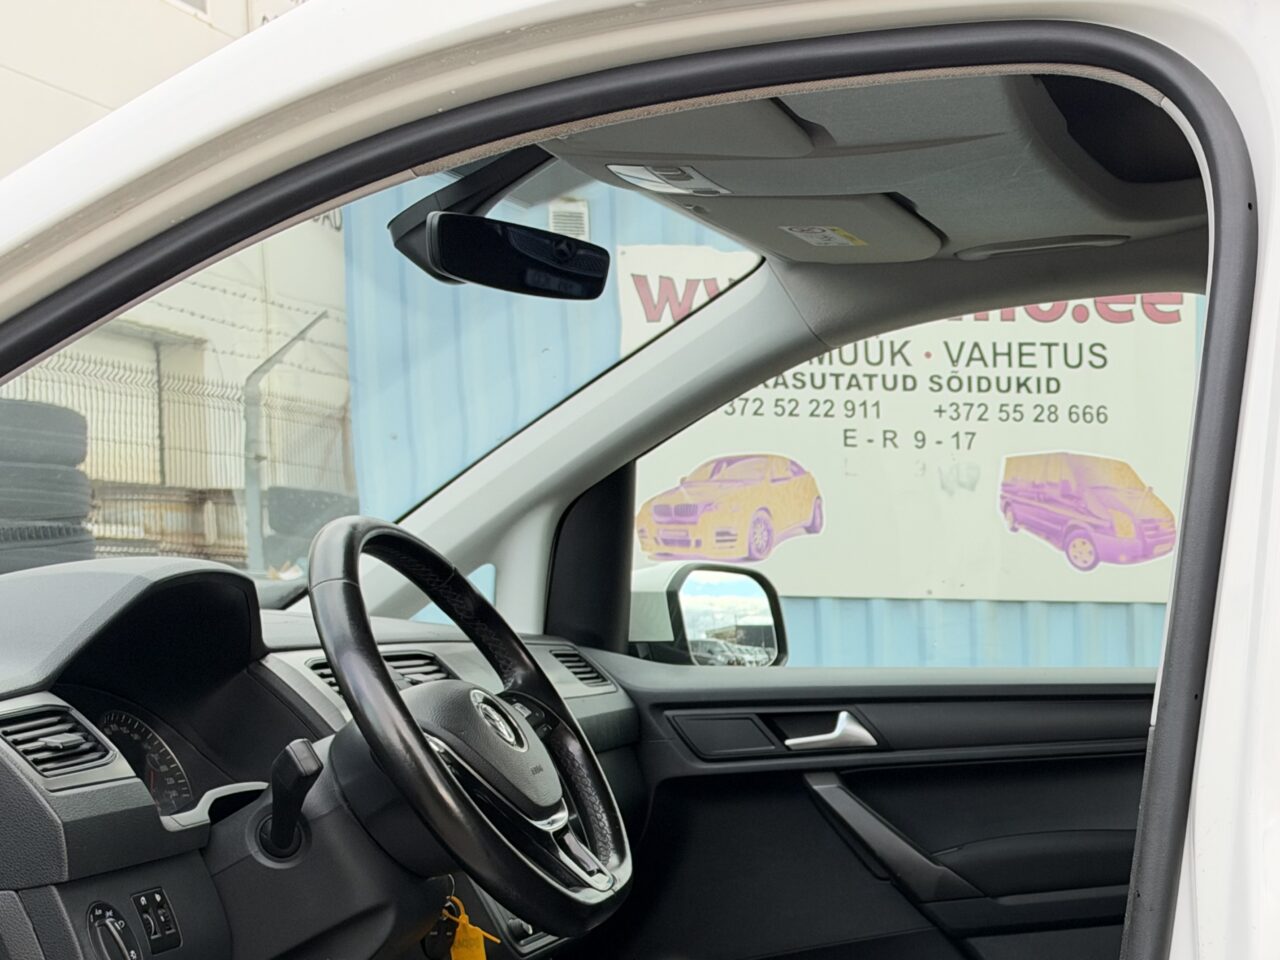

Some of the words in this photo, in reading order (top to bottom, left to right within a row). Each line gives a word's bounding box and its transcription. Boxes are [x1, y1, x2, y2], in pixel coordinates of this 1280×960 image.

[943, 340, 1108, 370] VAHETUS
[928, 370, 1061, 394] SÕIDUKID
[773, 398, 800, 418] 52
[808, 398, 835, 418] 22
[843, 399, 880, 419] 911
[933, 403, 989, 422] +372
[998, 404, 1025, 423] 55
[1033, 404, 1059, 424] 28
[1068, 404, 1108, 425] 666
